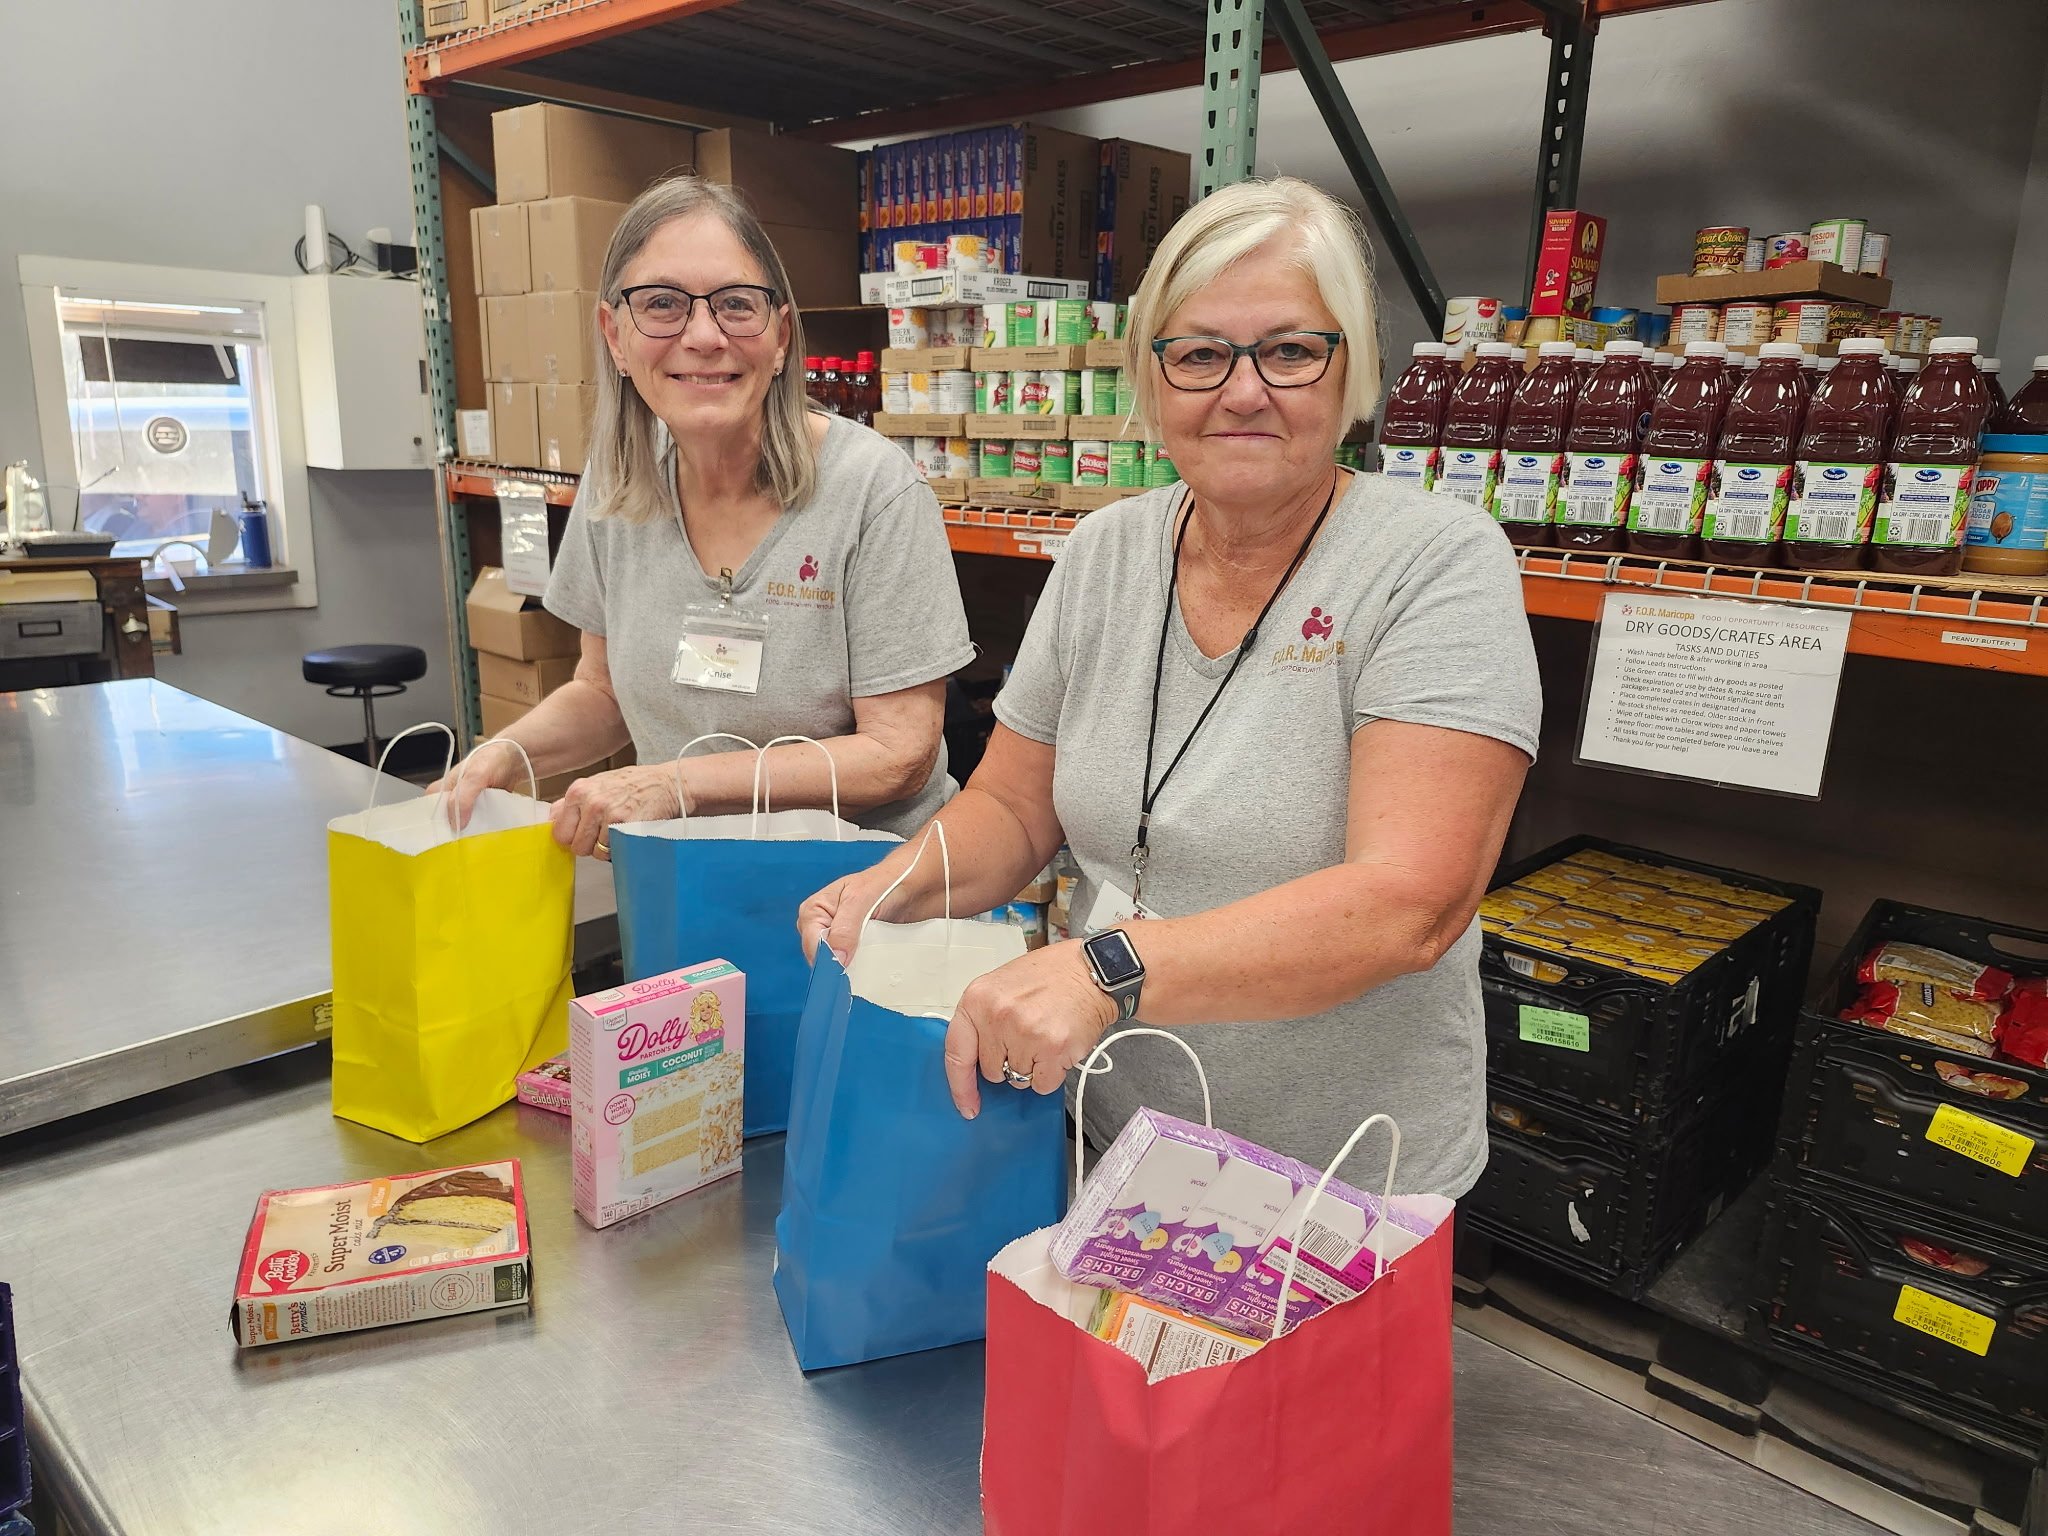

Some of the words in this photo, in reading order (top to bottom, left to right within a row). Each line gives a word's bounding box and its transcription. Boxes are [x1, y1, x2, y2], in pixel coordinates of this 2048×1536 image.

[1056, 160, 1066, 215] FLAKES
[1148, 166, 1160, 223] FLAKES
[1718, 230, 1745, 243] Choice
[1055, 222, 1064, 278] ROSTED
[1719, 254, 1740, 264] PEARS
[994, 277, 1011, 286] KROGER
[1570, 282, 1592, 298] RAISINS
[1475, 322, 1493, 331] APPLE
[1976, 479, 1997, 492] KIPPY
[768, 582, 797, 598] F.O.R.
[1636, 607, 1656, 616] F.O.R.
[1658, 608, 1695, 620] Maricopa
[1702, 614, 1721, 622] FOOD
[1728, 618, 1779, 627] OPPORTUNITY
[1786, 622, 1829, 632] RESOURCES
[1626, 620, 1654, 634] DRY
[1658, 623, 1775, 646] GOODS/CRATES
[1779, 635, 1822, 651] AREA
[1981, 639, 2010, 647] BUTTER
[1627, 648, 1644, 656] Wash
[1646, 650, 1665, 658] hands
[1666, 653, 1688, 661] before
[1715, 658, 1741, 667] working
[1676, 643, 1701, 653] TASKS
[1703, 646, 1724, 656] AND
[1726, 648, 1760, 659] DUTIES
[1625, 657, 1646, 665] Follow
[1648, 660, 1666, 668] Leads
[1637, 693, 1671, 703] completed
[1702, 701, 1739, 712] designated
[1618, 700, 1644, 709] Re-stock
[1646, 703, 1668, 712] shelves
[1708, 712, 1726, 720] Older
[1728, 714, 1746, 722] stock
[1756, 718, 1774, 726] front
[1616, 709, 1632, 717] Wipe
[1645, 712, 1663, 721] tables
[1681, 718, 1702, 726] Clorox
[1704, 720, 1723, 729] wipes
[1740, 726, 1760, 734] paper
[1762, 729, 1786, 738] towels
[1667, 735, 1701, 745] completed
[1704, 740, 1725, 748] before
[1742, 745, 1760, 753] leave
[692, 966, 725, 977] COCONUT
[632, 978, 677, 994] Dolly
[618, 1017, 690, 1061] Dolly
[640, 1046, 672, 1060] PARTON'S
[662, 1048, 703, 1068] COCONUT
[627, 1070, 651, 1083] MOIST
[531, 1094, 560, 1108] cuddly
[561, 1097, 571, 1105] cu
[609, 1098, 627, 1109] DOWN
[611, 1103, 627, 1114] HOME
[1970, 1136, 1988, 1146] TFSW
[329, 1199, 351, 1235] Moist
[324, 1236, 352, 1273] Super
[1094, 1241, 1114, 1252] Hearts
[1115, 1246, 1153, 1261] Conversation
[1100, 1251, 1121, 1260] Bright
[1123, 1257, 1139, 1265] Sweet
[1167, 1258, 1187, 1269] Hearts
[265, 1256, 289, 1281] Betty
[280, 1250, 300, 1282] Crocker
[1084, 1258, 1141, 1279] BRACHS
[1189, 1264, 1226, 1283] Conversation
[1175, 1269, 1196, 1281] Bright
[1198, 1278, 1214, 1286] Sweet
[448, 1282, 456, 1301] Betty
[1157, 1274, 1215, 1301] BRACHS
[1241, 1284, 1262, 1298] Hearts
[1246, 1295, 1267, 1310] Bright
[246, 1303, 254, 1324] Moist
[288, 1302, 300, 1335] Betty's
[300, 1301, 312, 1333] promise
[1230, 1300, 1288, 1326] RACHS
[249, 1325, 257, 1344] Super
[1210, 1342, 1224, 1364] Calo
